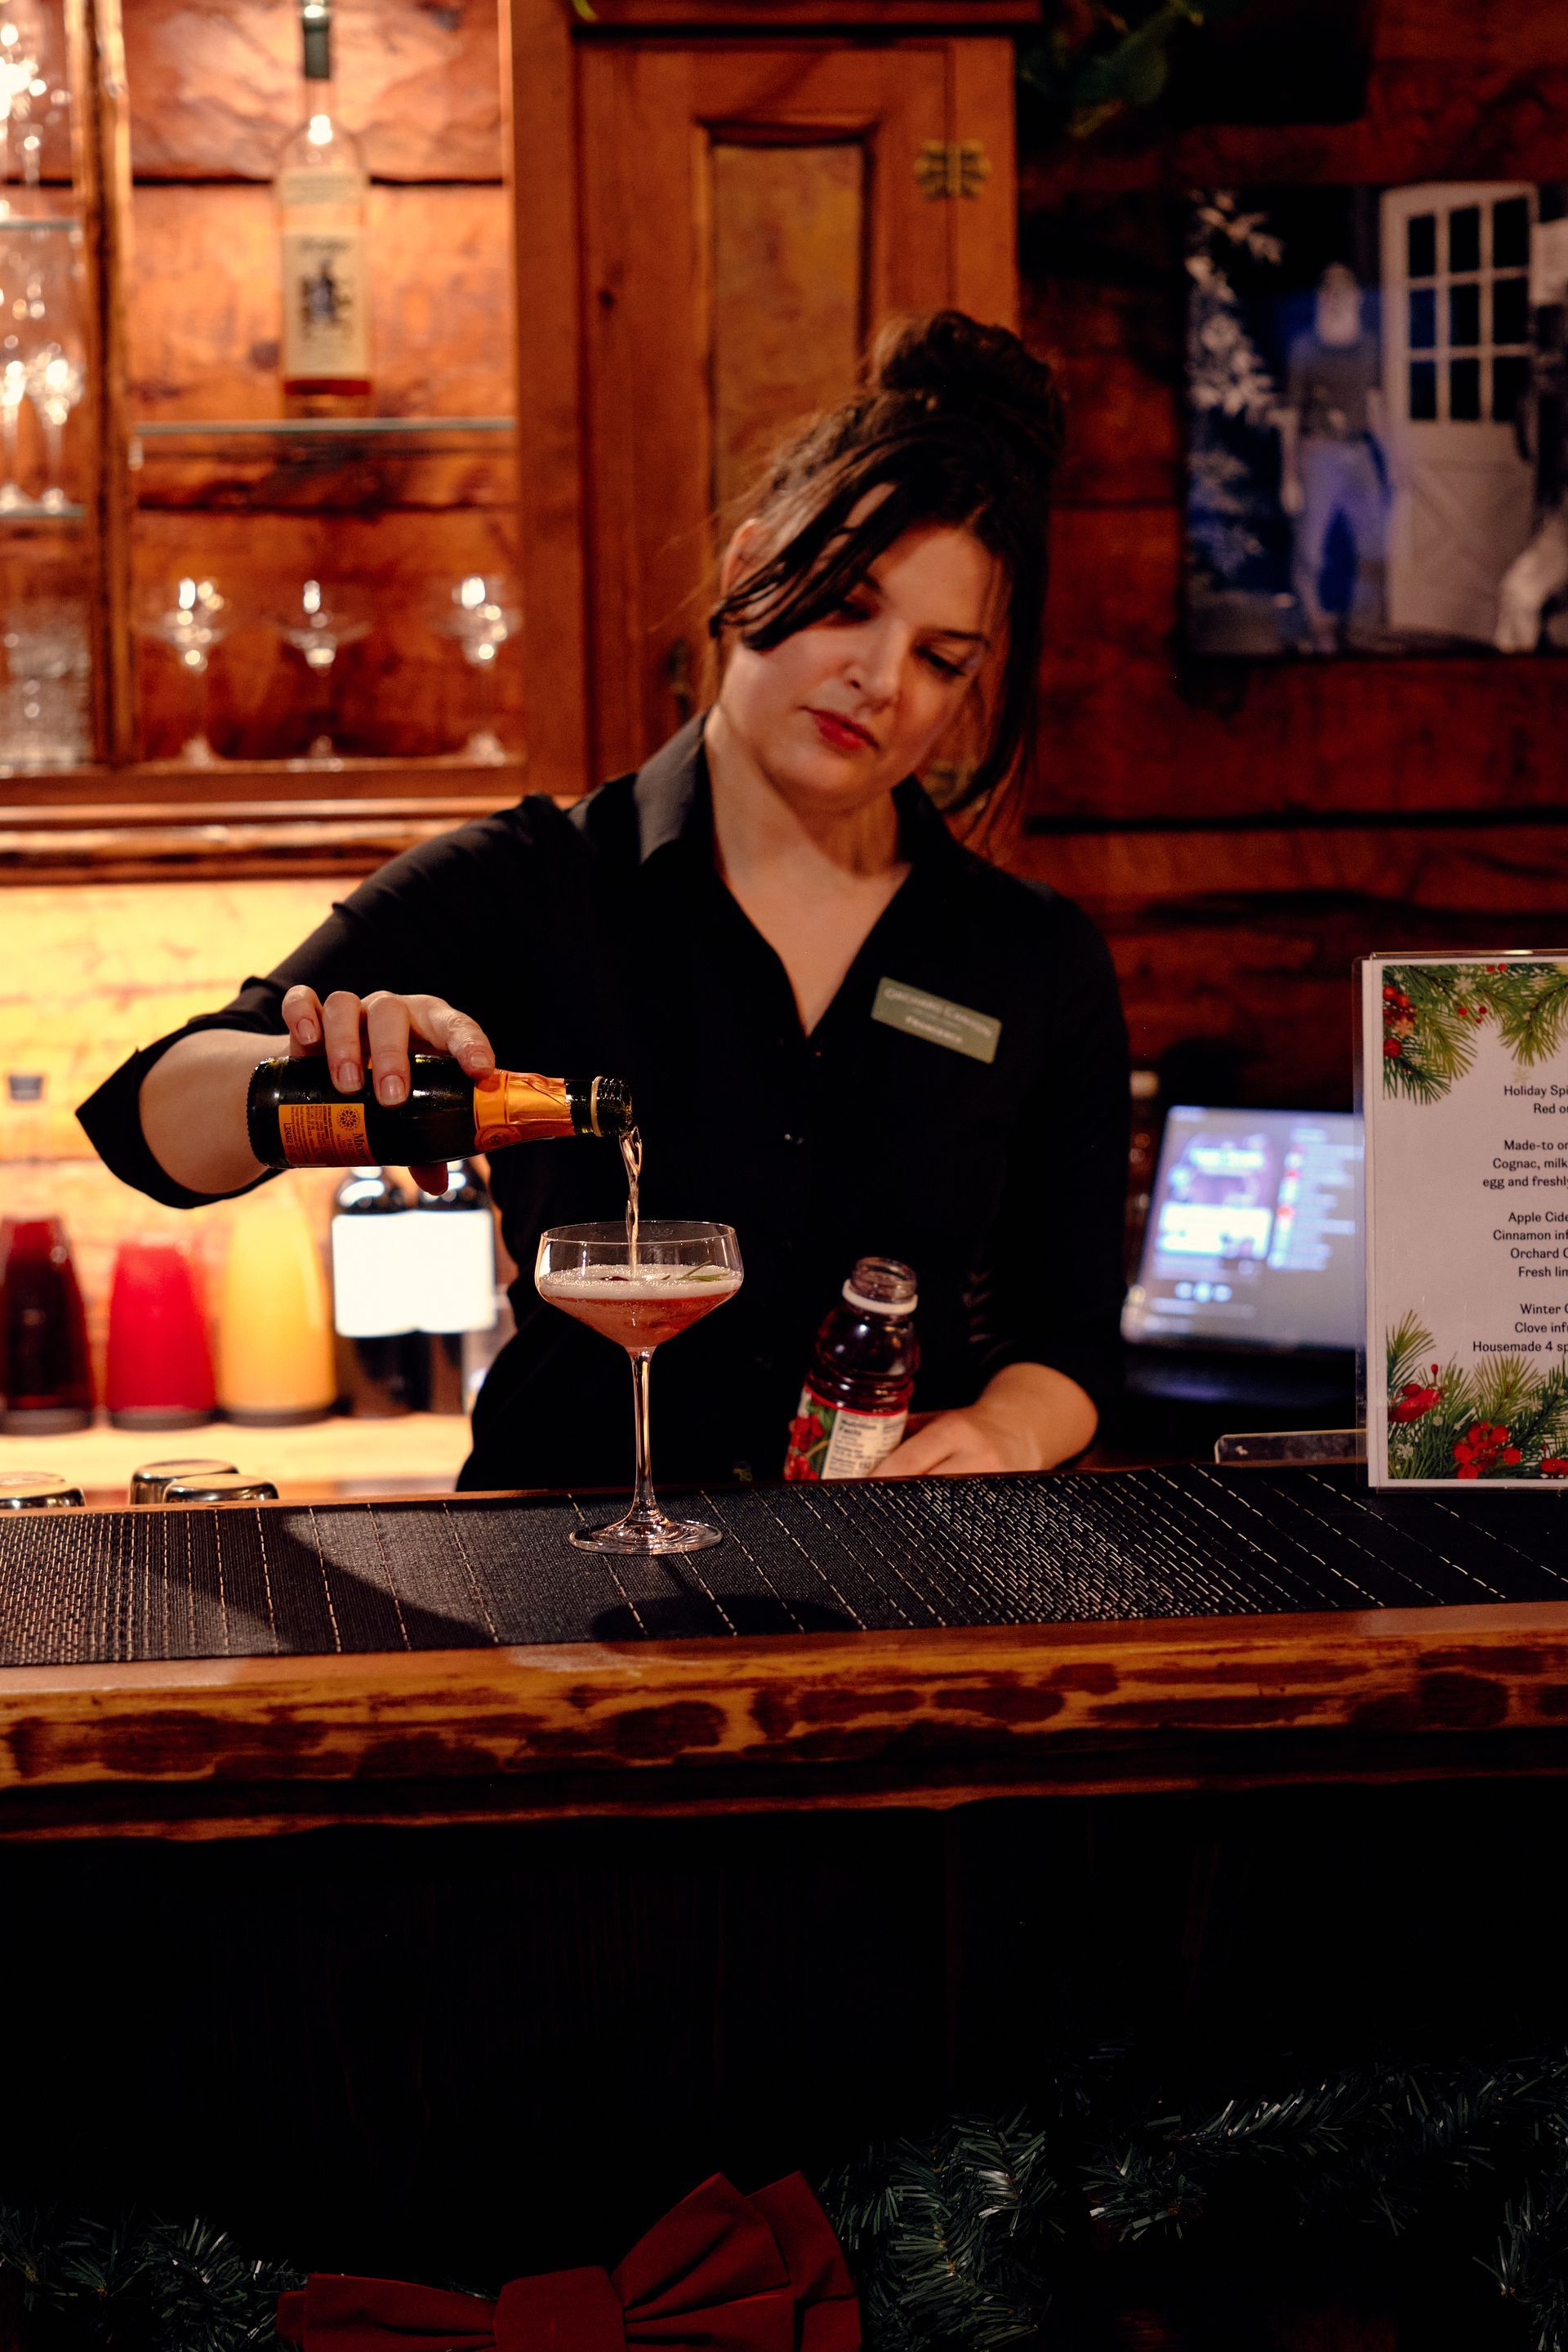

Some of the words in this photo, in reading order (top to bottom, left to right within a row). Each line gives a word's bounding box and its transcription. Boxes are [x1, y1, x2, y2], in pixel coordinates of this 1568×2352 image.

[1504, 1085, 1547, 1098] Holiday
[1534, 1103, 1556, 1114] Red
[1504, 1139, 1554, 1150] Made-to
[1493, 1158, 1540, 1171] Cognac,
[1544, 1157, 1567, 1168] milk
[1483, 1178, 1505, 1190] egg
[1508, 1177, 1529, 1187] and
[1508, 1211, 1541, 1225] Apple
[1493, 1229, 1551, 1241] Cinnamon
[1511, 1248, 1559, 1258] Orchard
[1518, 1266, 1552, 1277] Fresh
[1520, 1303, 1561, 1314] Winter
[1515, 1321, 1548, 1333] Clove
[1472, 1340, 1542, 1352] Housemade
[1545, 1341, 1552, 1351] 4
